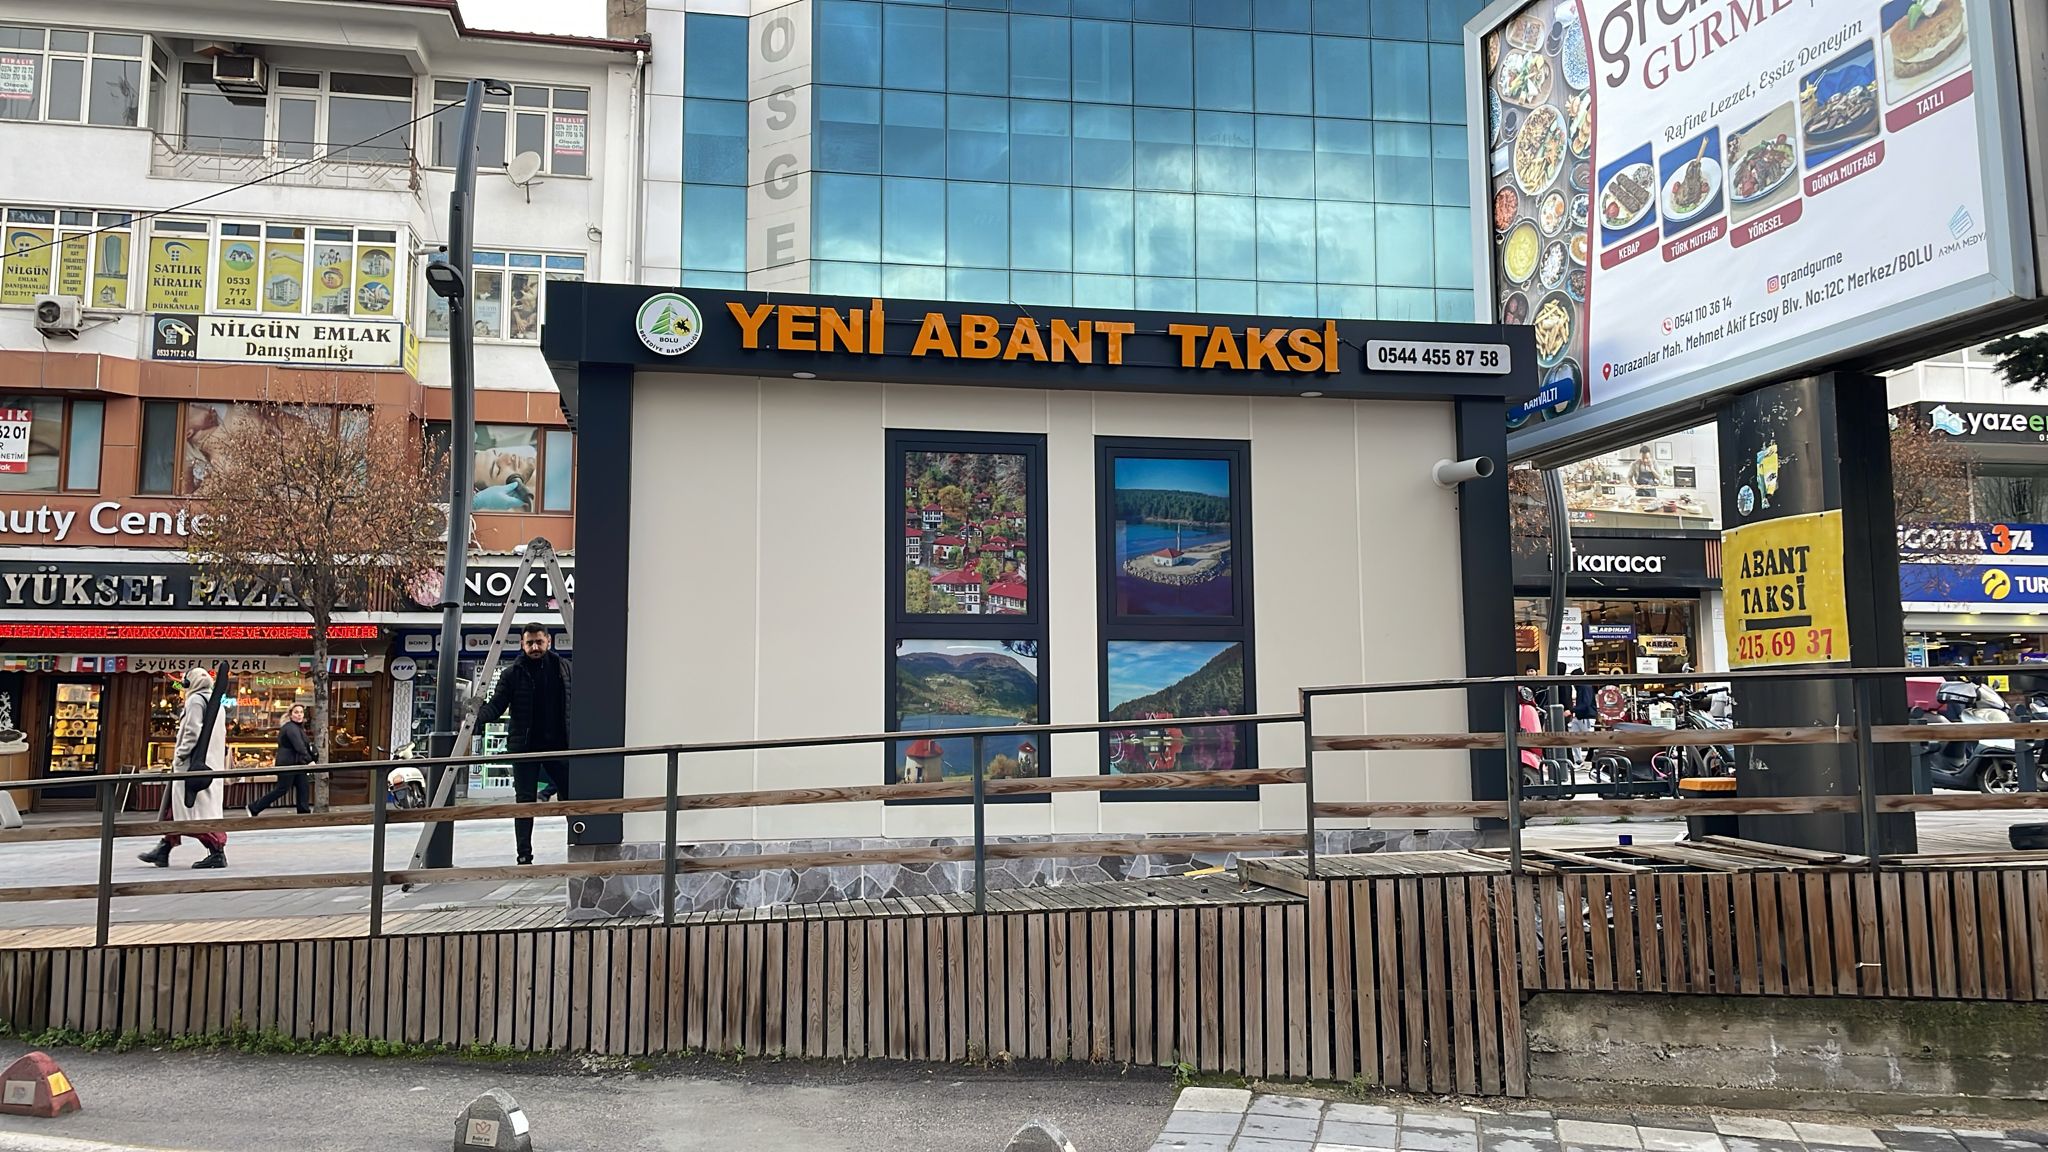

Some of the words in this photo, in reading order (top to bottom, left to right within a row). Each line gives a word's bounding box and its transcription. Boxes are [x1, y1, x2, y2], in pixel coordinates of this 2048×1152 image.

[1664, 111, 1708, 143] Rafine
[1710, 81, 1756, 120] Lezzet,
[1759, 58, 1796, 90] Eşsiz
[1798, 20, 1863, 67] Deneyim
[1916, 90, 1945, 115] TATLI
[760, 16, 798, 272] OSGE
[1811, 170, 1840, 193] DÜNYA
[1840, 151, 1877, 180] MUTFAĞI
[1747, 214, 1784, 240] YÖRESEL
[1618, 240, 1640, 261] KEBAP
[1670, 238, 1689, 258] TÜRK
[1689, 226, 1719, 251] MUTFAĞI
[6, 264, 49, 276] NİLGÜN
[154, 263, 202, 275] SATILIK
[1780, 251, 1843, 289] grandgurme
[153, 275, 203, 289] KİRALIK
[226, 276, 251, 286] 0533
[229, 288, 247, 296] 717
[152, 302, 200, 311] DÜKKANLAR
[224, 297, 236, 305] 21
[239, 298, 252, 306] 43
[1613, 350, 1660, 378] Borazanlar
[1662, 341, 1684, 360] Mah.
[1685, 326, 1724, 352] Mehmet
[1726, 314, 1746, 336] Akif
[1749, 305, 1779, 328] Ersoy
[1782, 297, 1802, 316] Blv.
[1805, 277, 1845, 307] No:12C
[1847, 243, 1933, 292] Merkez/BOLU
[1674, 311, 1693, 330] 0541
[1694, 305, 1707, 321] 110
[1709, 299, 1721, 317] 36
[1722, 295, 1732, 312] 14
[210, 319, 300, 339] NİLGÜN
[313, 326, 392, 343] EMLAK
[639, 330, 663, 353] BELEDİYE
[725, 298, 885, 355] YENİ
[910, 312, 1136, 366] ABANT
[1168, 319, 1340, 373] TAKSİ
[156, 349, 170, 357] 0533
[170, 349, 180, 357] 717
[180, 350, 187, 358] 21
[187, 350, 195, 358] 43
[245, 342, 353, 362] Danışmanlığı
[1377, 346, 1418, 365] 0544
[1421, 347, 1451, 366] 455
[1455, 348, 1475, 367] 87
[1479, 349, 1500, 368] 58
[0, 409, 29, 421] IK
[1967, 412, 2048, 435] yazee
[13, 425, 26, 440] 01
[1990, 524, 2034, 554] 374
[1577, 555, 1663, 573] karaca
[1740, 545, 1810, 579] ABANT
[2, 565, 175, 607] YÜKSEL
[1740, 575, 1807, 614] TAKSİ
[1771, 630, 1796, 657] 69
[1806, 628, 1833, 656] 37
[149, 657, 204, 671] YÜKSEL
[212, 658, 267, 671] PZARI
